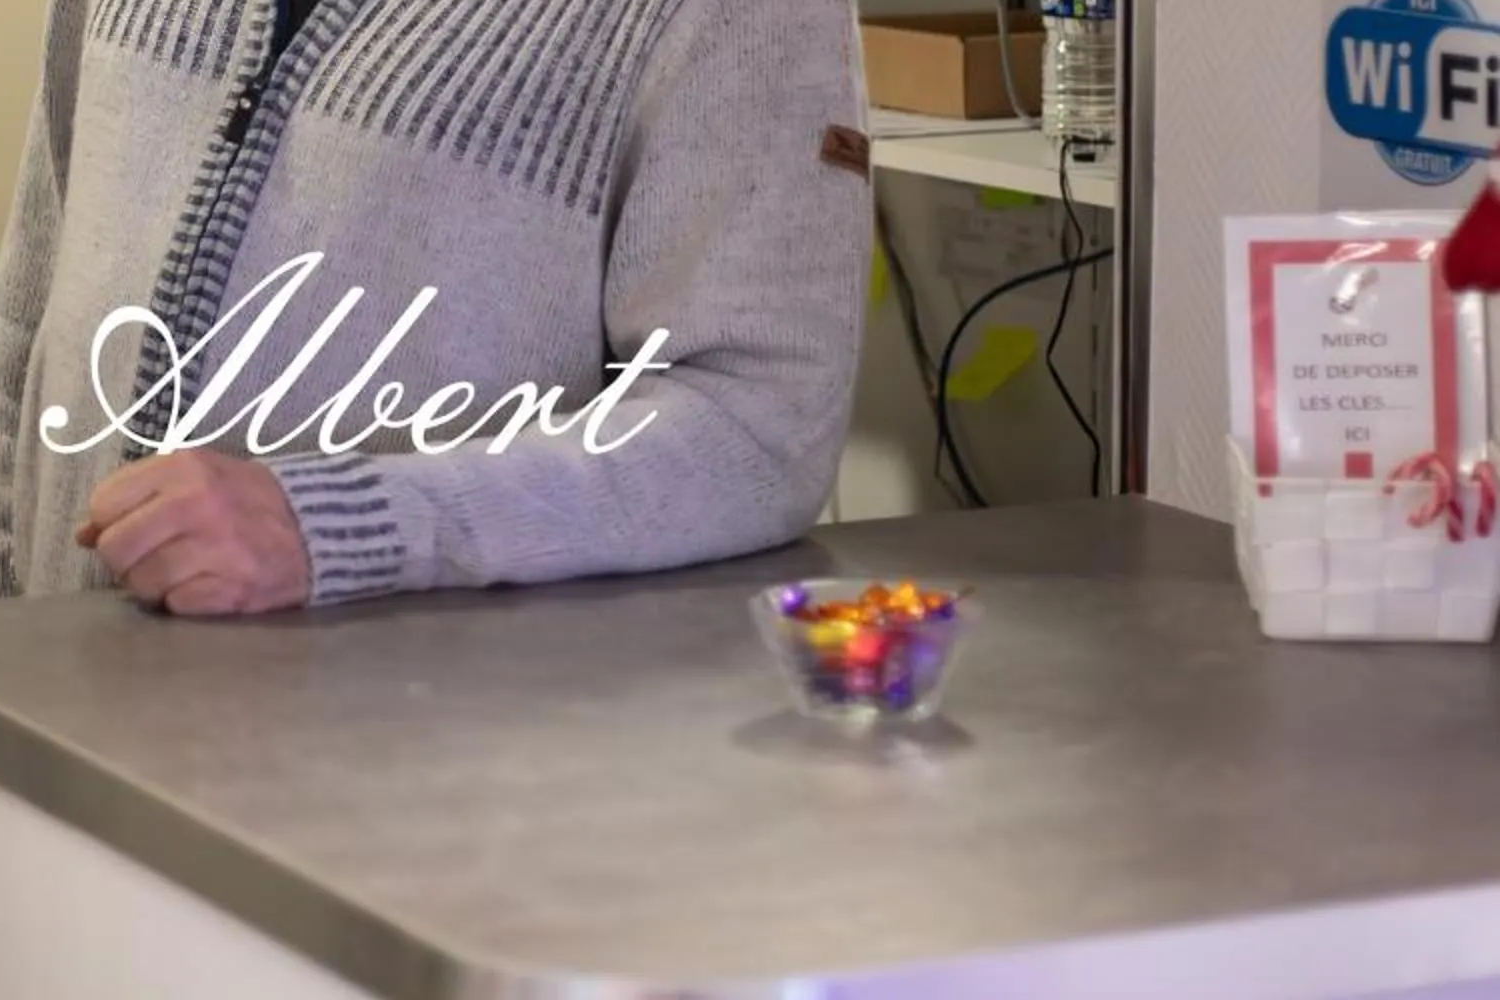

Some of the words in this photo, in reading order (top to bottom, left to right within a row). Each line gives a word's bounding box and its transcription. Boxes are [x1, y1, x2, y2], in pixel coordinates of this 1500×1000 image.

[1321, 332, 1388, 349] MERCI
[1293, 364, 1319, 379] DE
[1299, 396, 1331, 411] LES
[1344, 426, 1370, 441] ICI
